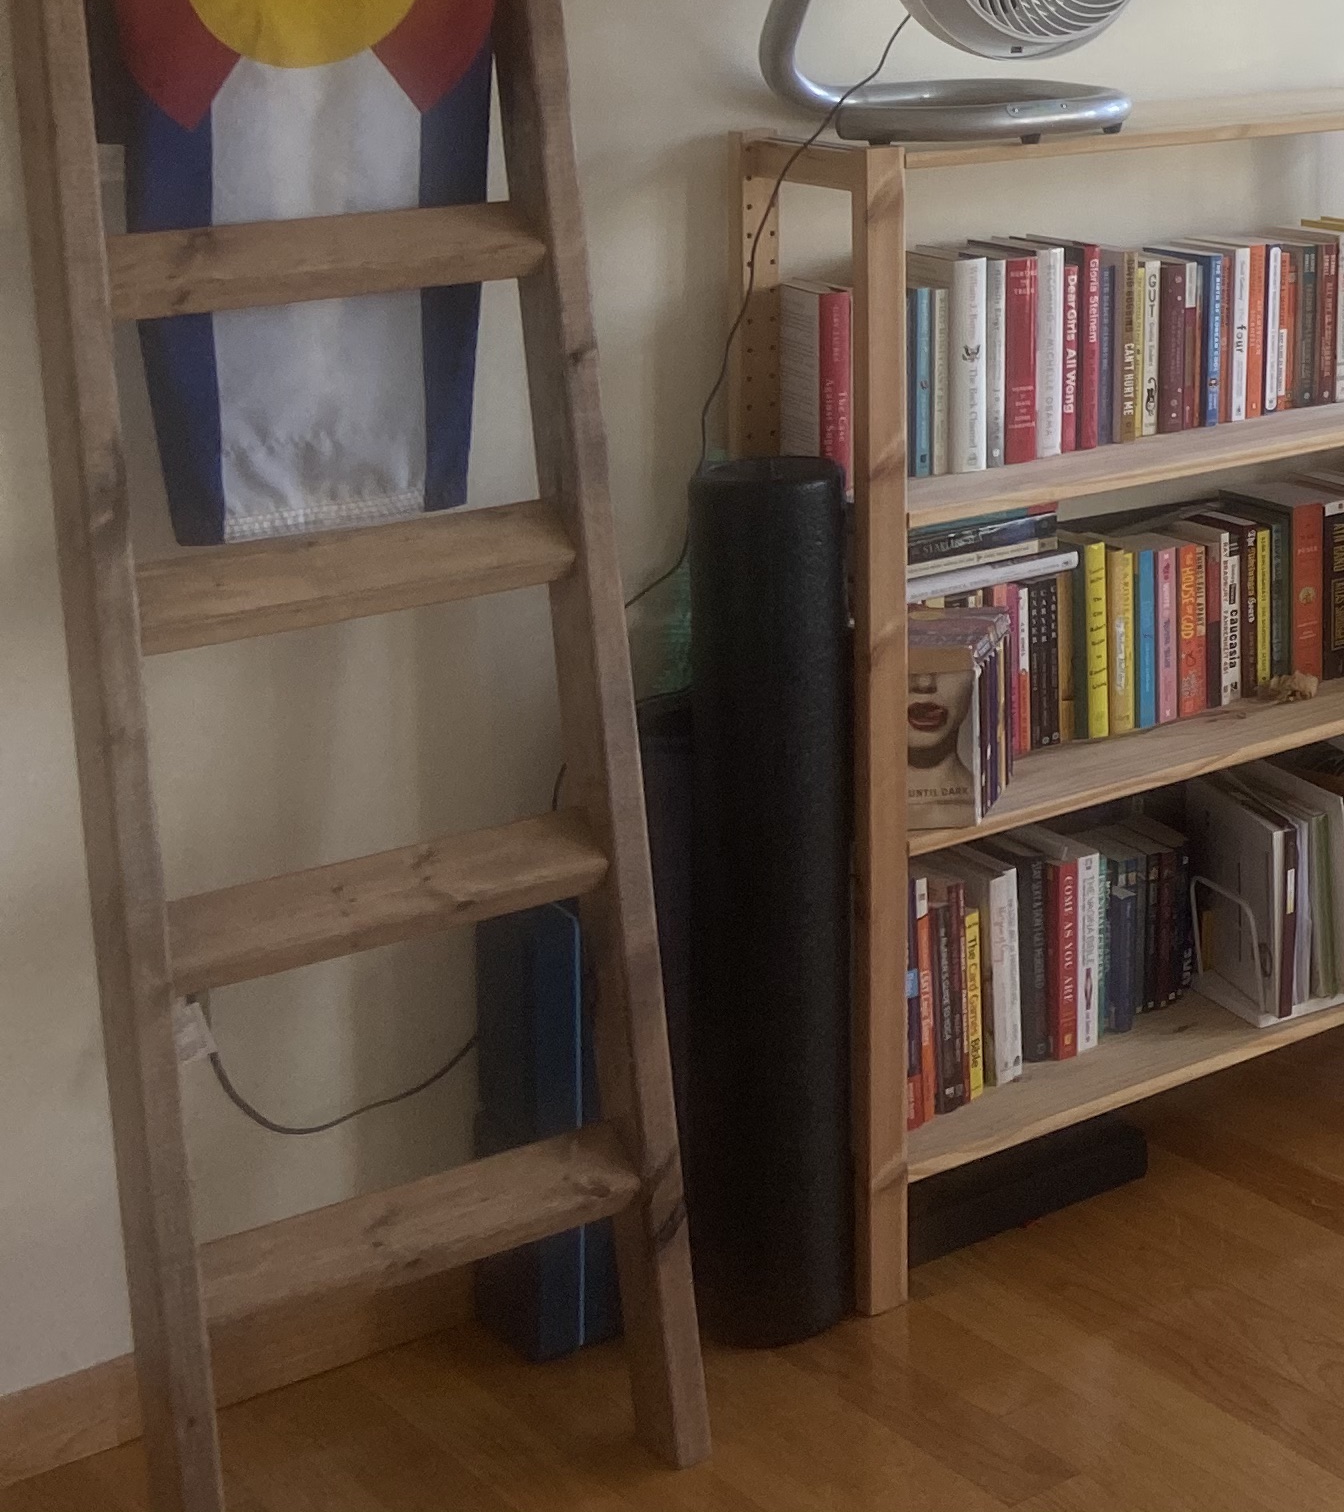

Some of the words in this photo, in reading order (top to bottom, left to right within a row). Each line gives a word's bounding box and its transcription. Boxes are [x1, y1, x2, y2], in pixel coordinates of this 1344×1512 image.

[1088, 258, 1099, 293] Gloria
[1067, 274, 1077, 308] Dear
[1147, 273, 1158, 319] GUT
[1066, 309, 1076, 341] Girls
[1088, 295, 1098, 344] Steinem
[1235, 324, 1247, 354] four
[1045, 338, 1054, 391] MICHELLE
[1065, 348, 1076, 368] Ali
[1123, 342, 1135, 371] CAN'T
[968, 368, 978, 385] The
[1123, 373, 1135, 399] HURT
[1063, 370, 1075, 414] Wong
[1045, 396, 1053, 437] OBAMA
[1122, 400, 1134, 416] ME
[1181, 567, 1195, 604] HOUSE
[1180, 615, 1195, 640] GOD
[908, 789, 938, 798] UNTIL
[941, 786, 970, 797] DARK
[1063, 875, 1075, 917] COME
[1063, 921, 1074, 940] AS
[968, 937, 978, 960] The
[1063, 941, 1075, 970] YOU
[969, 962, 979, 989] Card
[1062, 975, 1074, 1004] ARE
[969, 993, 980, 1035] Games
[970, 1037, 981, 1070] Bible
